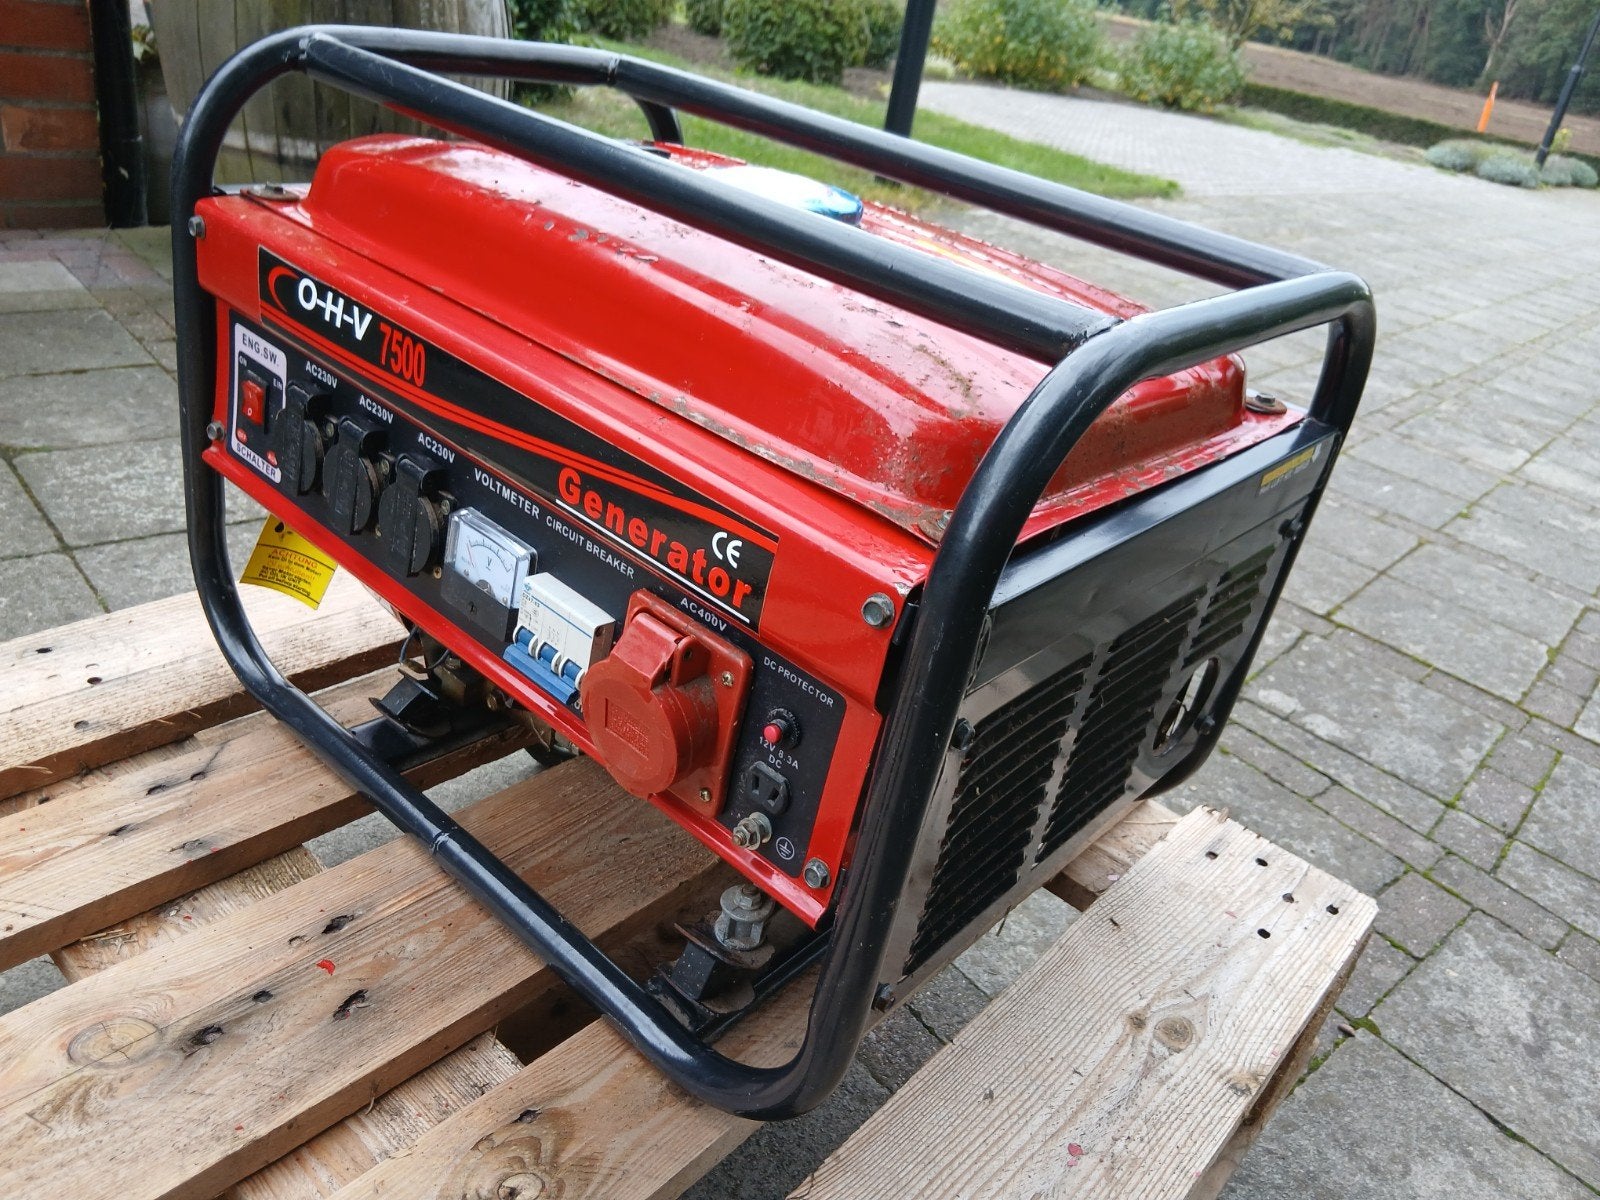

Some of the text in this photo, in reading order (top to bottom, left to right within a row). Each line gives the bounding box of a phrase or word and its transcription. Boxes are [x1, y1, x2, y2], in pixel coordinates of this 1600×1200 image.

[298, 277, 426, 387] O-H-V 7500
[305, 360, 338, 389] AC230V
[359, 394, 394, 424] AC230V
[236, 443, 277, 478] SCHALTER
[418, 431, 456, 464] AC230V
[474, 467, 540, 520] VOLTMETER
[546, 515, 635, 579] CIRCUIT BREAKER
[558, 466, 753, 608] Generator
[712, 530, 743, 568] CE
[680, 597, 728, 632] AC400V
[763, 656, 834, 708] DC PROTECTOR
[759, 736, 800, 770] 12V 8.3A
[768, 754, 783, 770] DC
